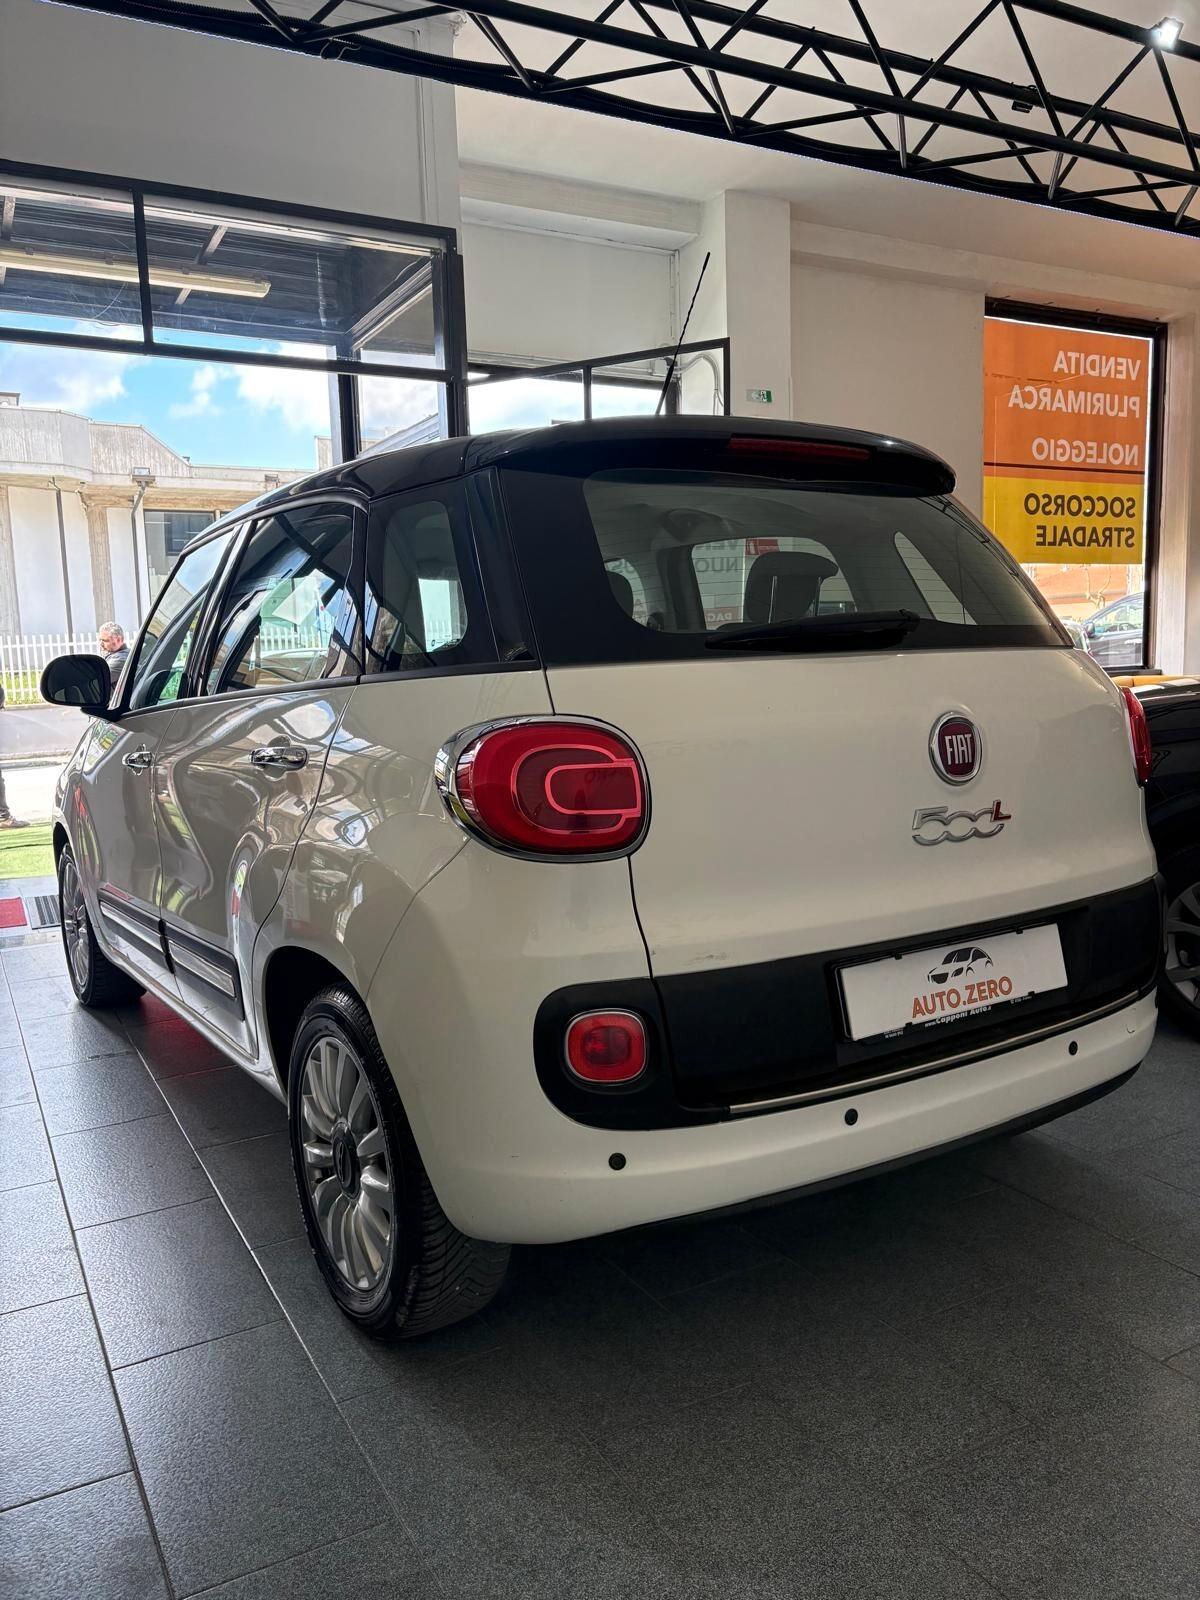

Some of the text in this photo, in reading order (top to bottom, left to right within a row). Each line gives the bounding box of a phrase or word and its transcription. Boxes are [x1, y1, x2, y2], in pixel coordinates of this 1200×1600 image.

[944, 733, 973, 765] FIAT
[912, 799, 1011, 846] 500L
[912, 976, 1013, 1018] AUTO.ZERO
